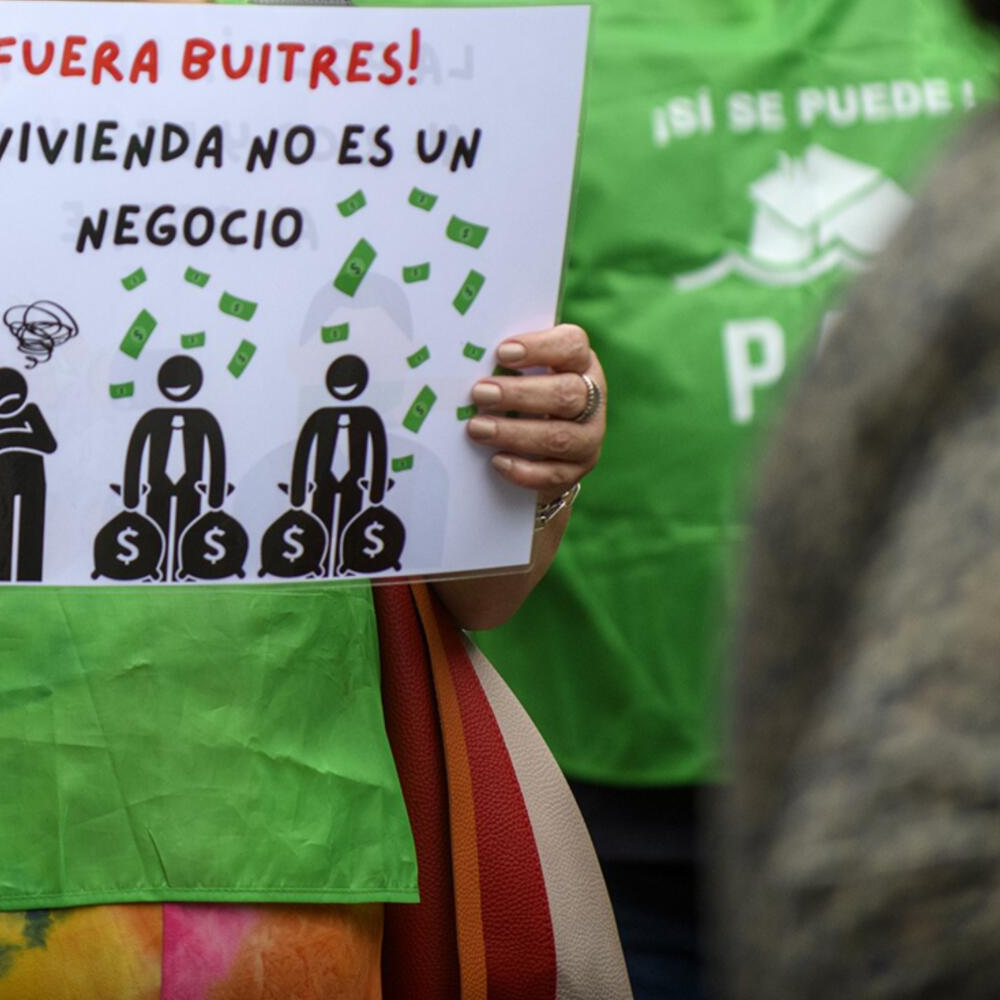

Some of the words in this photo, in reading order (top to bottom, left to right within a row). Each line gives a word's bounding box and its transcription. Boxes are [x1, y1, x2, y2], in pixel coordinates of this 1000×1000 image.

[181, 28, 421, 89] BUITRES!
[728, 91, 784, 131] SE
[245, 124, 316, 173] NO
[337, 124, 394, 168] ES
[416, 127, 482, 173] UN
[75, 203, 303, 254] NEGOCIO
